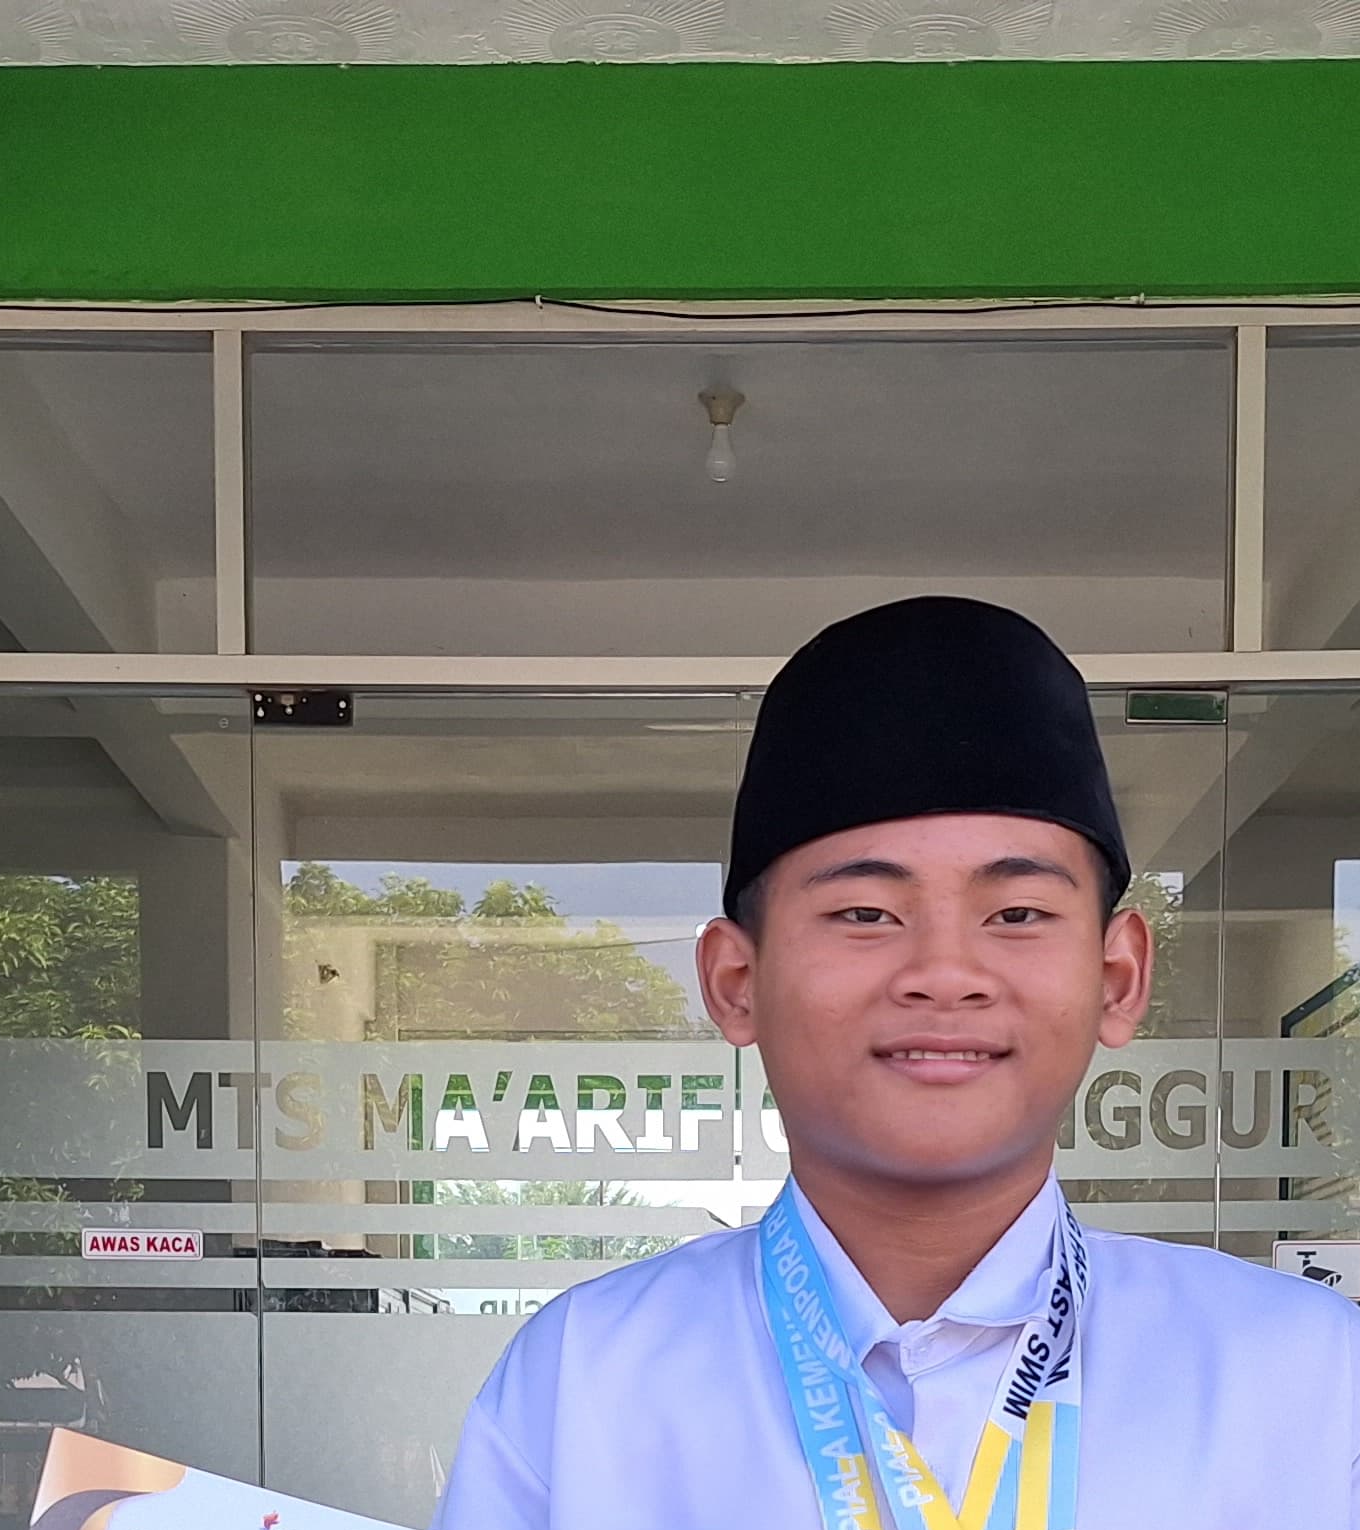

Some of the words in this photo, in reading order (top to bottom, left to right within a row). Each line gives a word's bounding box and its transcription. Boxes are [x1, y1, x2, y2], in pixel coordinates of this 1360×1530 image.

[146, 1071, 325, 1151] MTS
[88, 1234, 140, 1254] AWAS
[146, 1235, 197, 1253] KACA
[770, 1235, 855, 1370] MENPORA
[1002, 1333, 1051, 1421] SWIM
